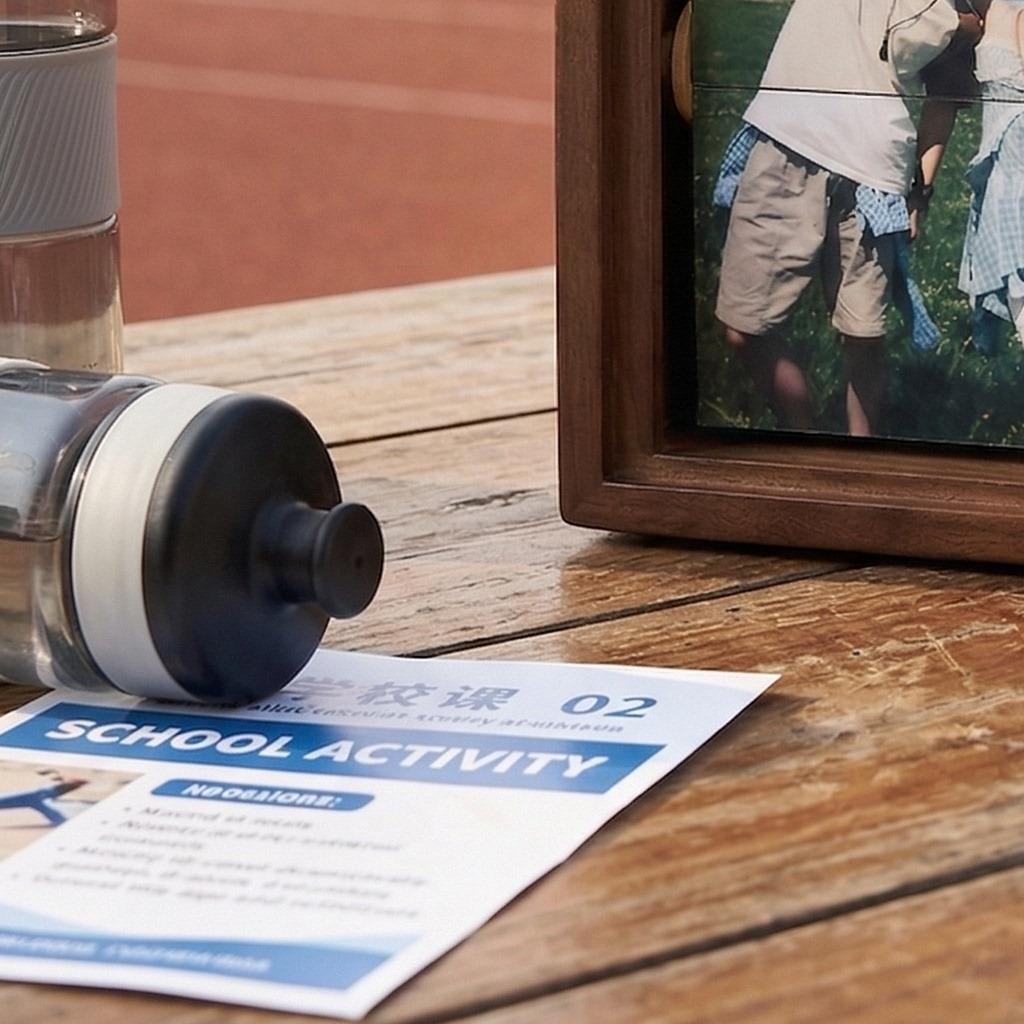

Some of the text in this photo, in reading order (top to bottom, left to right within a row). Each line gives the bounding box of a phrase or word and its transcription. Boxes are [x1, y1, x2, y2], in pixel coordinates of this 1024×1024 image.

[560, 693, 658, 719] 02
[47, 719, 608, 779] SCHOOL ACTIVITY
